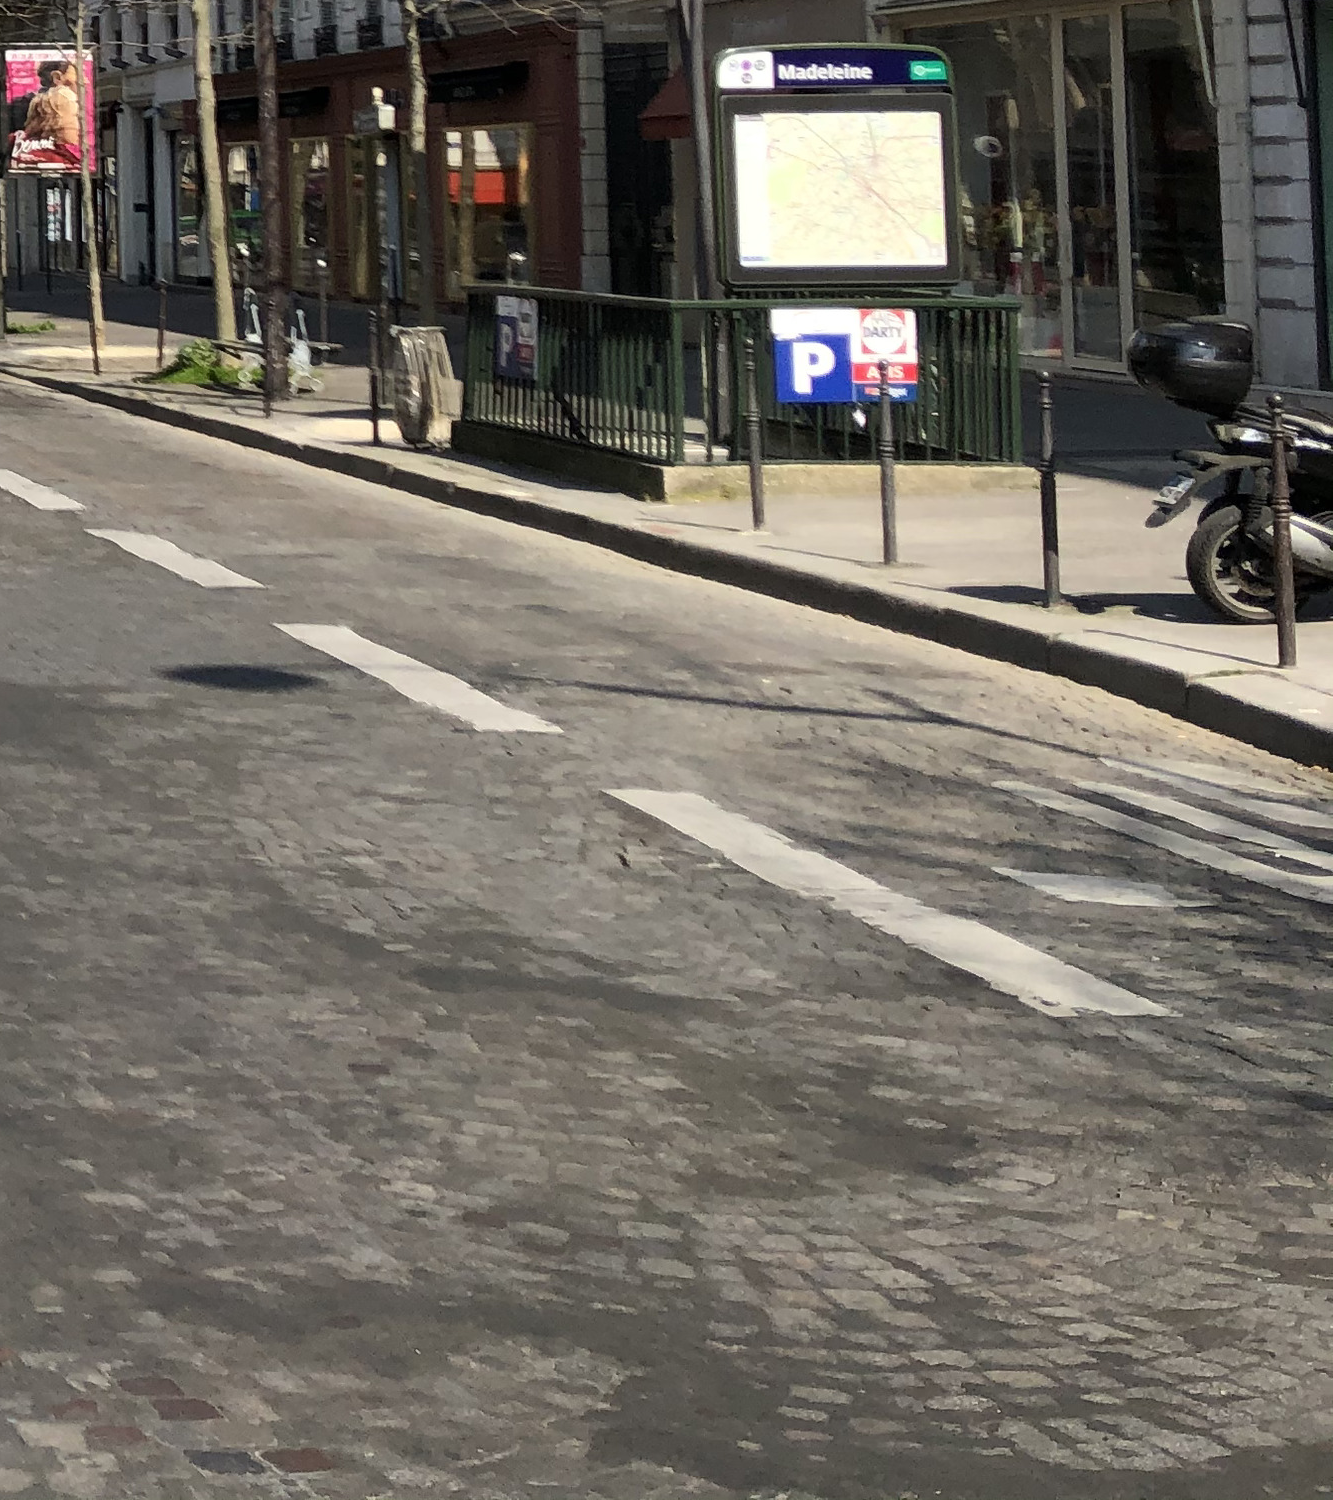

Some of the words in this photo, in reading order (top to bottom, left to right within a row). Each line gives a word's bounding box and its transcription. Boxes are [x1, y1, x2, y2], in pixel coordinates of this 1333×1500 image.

[777, 63, 873, 81] Madeleine
[792, 342, 836, 394] P
[866, 366, 905, 378] AIS
